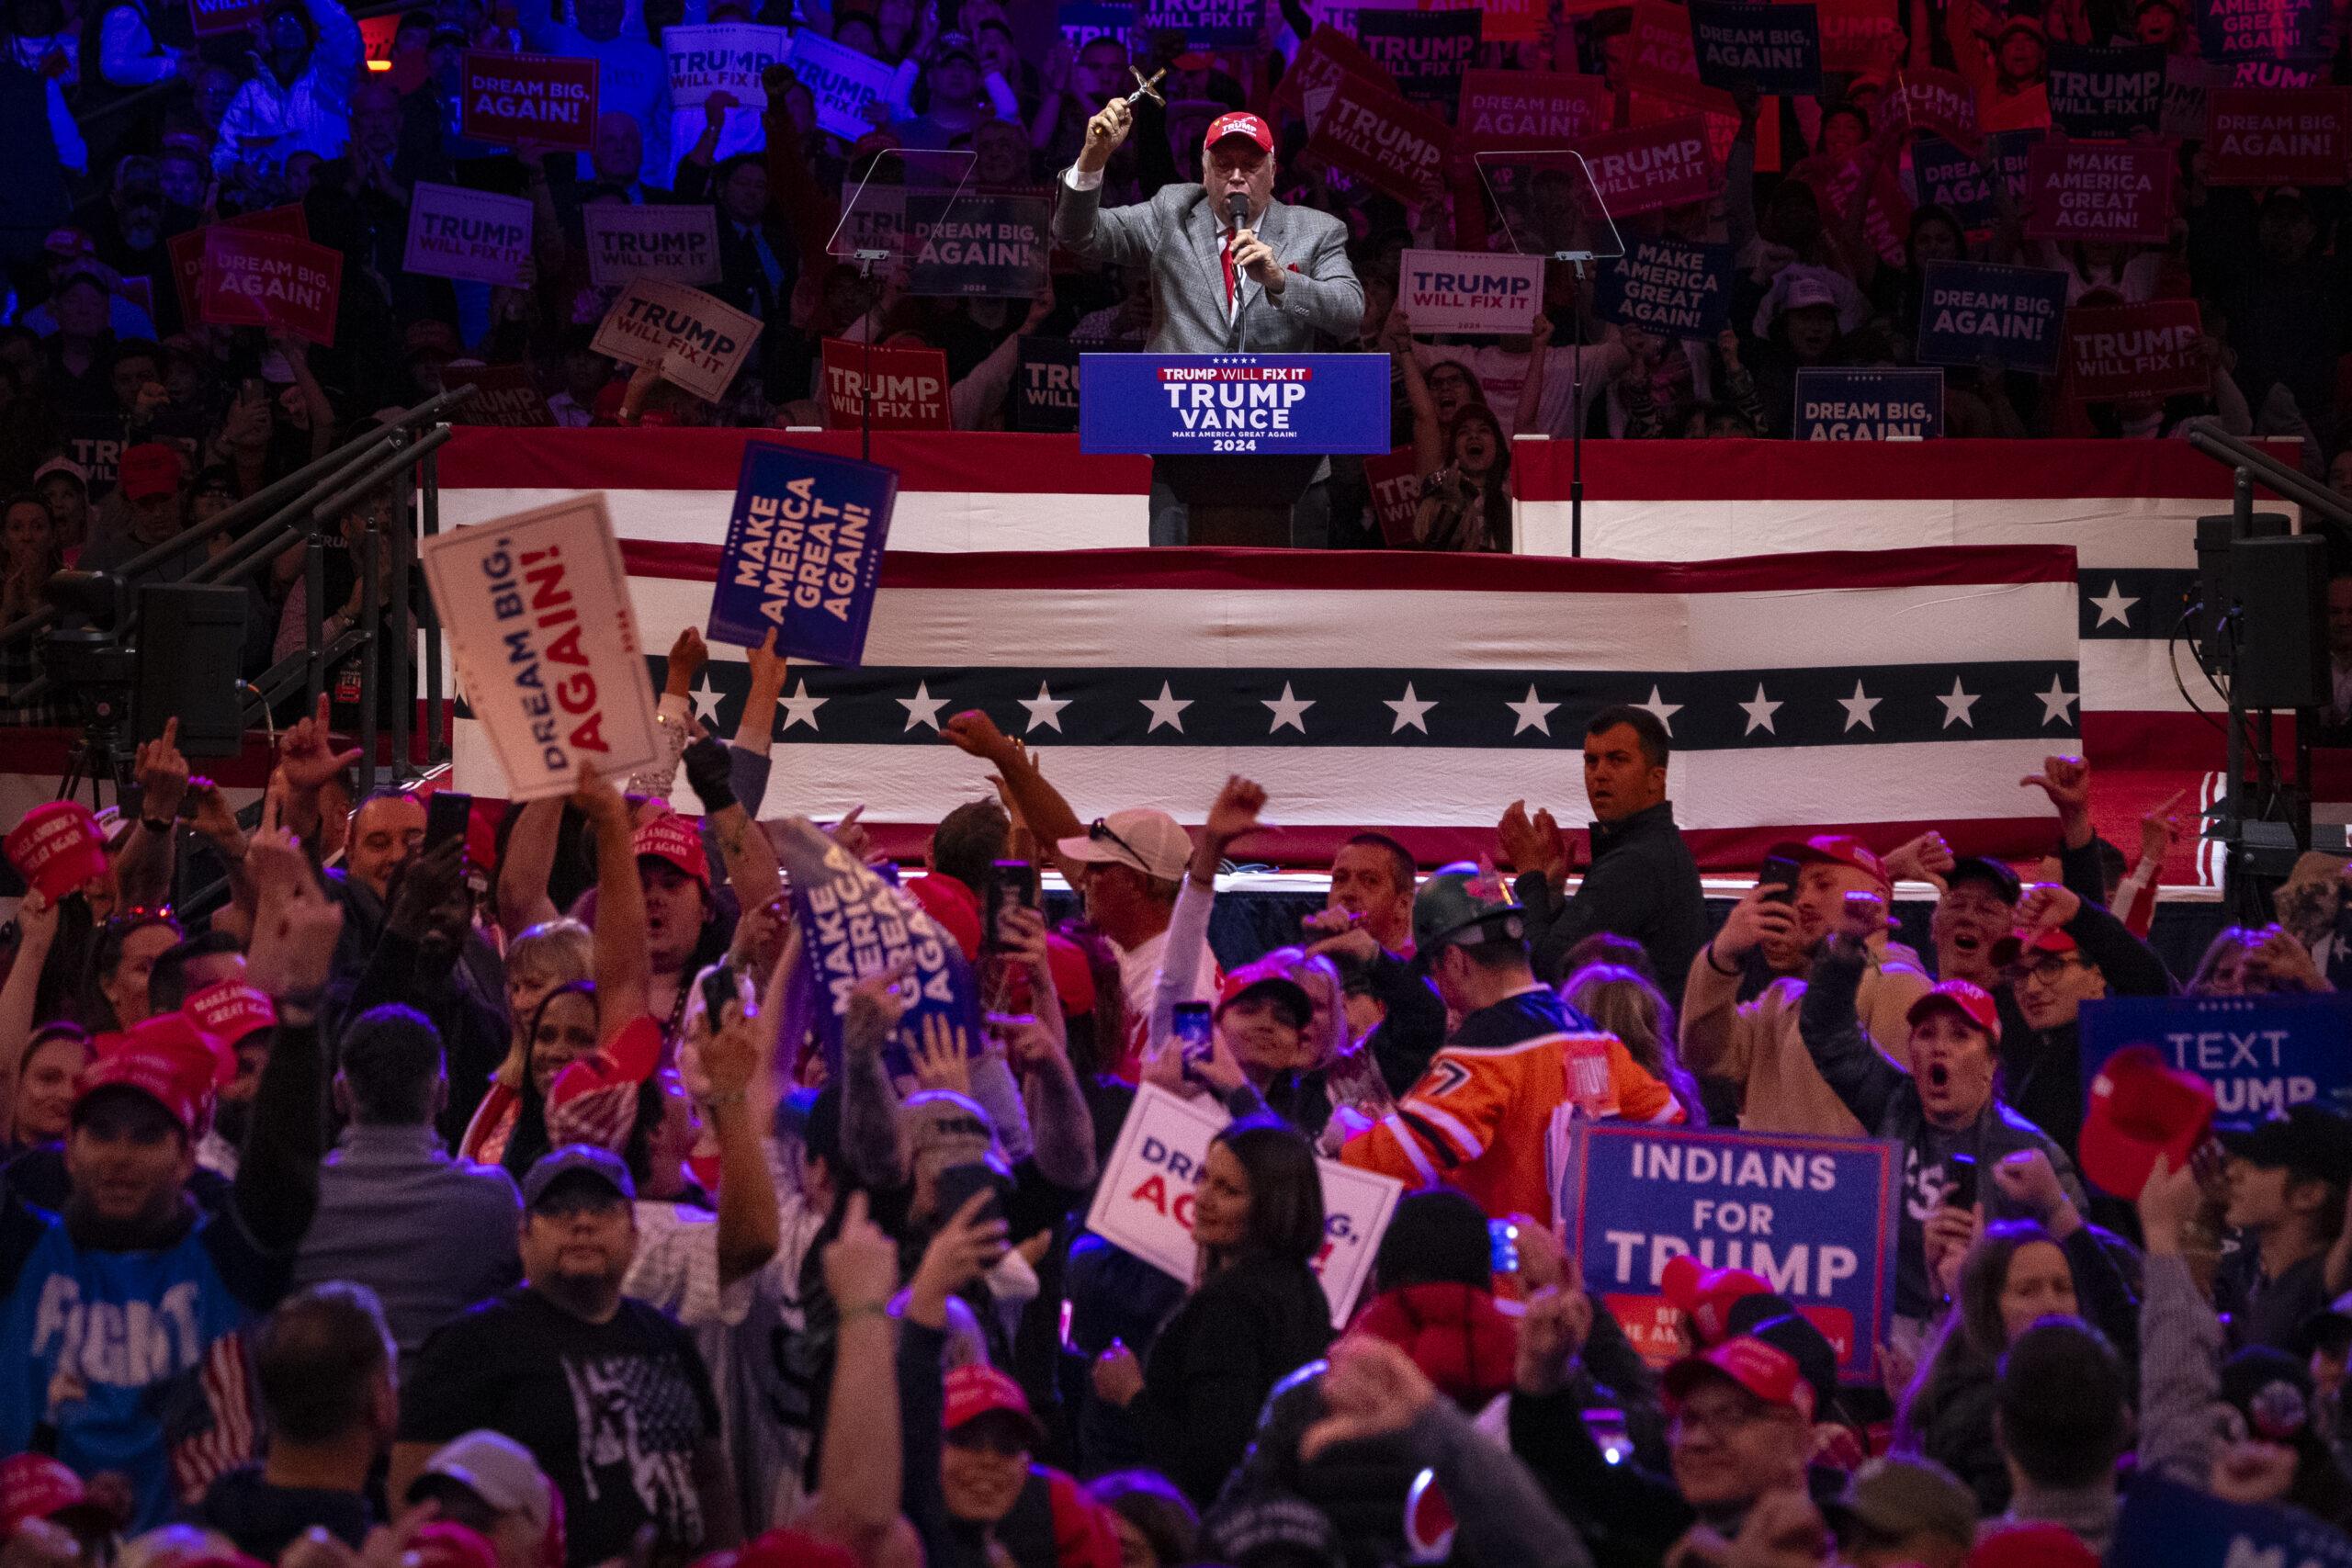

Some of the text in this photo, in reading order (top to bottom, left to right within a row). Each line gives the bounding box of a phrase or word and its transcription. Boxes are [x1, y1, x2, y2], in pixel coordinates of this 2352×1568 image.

[1145, 12, 1256, 28] WILL FIX IT
[1823, 17, 1896, 38] UMP
[1363, 35, 1474, 62] TRUMP
[1700, 23, 1811, 47] DREAM BIG,
[669, 50, 775, 73] TRUMP
[1379, 60, 1415, 76] ILL
[1420, 60, 1453, 76] FIX
[1638, 46, 1699, 78] AGA
[1706, 43, 1803, 69] AGAIN!
[471, 73, 590, 103] DREAM BIG,
[670, 73, 713, 89] WILL
[718, 72, 748, 86] FIX
[793, 56, 876, 104] TRUMP
[2050, 69, 2161, 98] TRUMP
[2235, 61, 2316, 88] RUM
[474, 93, 581, 124] AGAIN!
[1472, 95, 1589, 117] DREAM BIG,
[2050, 96, 2098, 115] WILL
[2103, 97, 2138, 115] FIX
[2143, 95, 2159, 113] IT
[1338, 96, 1442, 167] TRUMP
[1473, 111, 1581, 138] AGAIN!
[2217, 114, 2341, 133] DREAM BIG,
[1329, 119, 1371, 157] WILL
[1376, 147, 1410, 177] FIX
[2219, 133, 2332, 157] AGAIN!
[1582, 139, 1702, 182] TRUMP
[1645, 167, 1679, 187] FIX
[1684, 160, 1704, 178] IT
[2066, 153, 2134, 172] MAKE
[1933, 174, 2027, 206] AGAN
[2044, 172, 2153, 191] AMERICA
[2058, 191, 2139, 209] GREAT
[422, 212, 524, 247] TRUMP
[915, 221, 1040, 244] DREAM BIG,
[2055, 209, 2139, 229] AGAIN!
[419, 235, 522, 263] WILL FIX IT
[597, 231, 707, 253] TRUMP
[918, 242, 1031, 266] AGAIN!
[601, 252, 707, 266] WILL FIX IT
[1637, 243, 1705, 272] MAKE
[216, 253, 293, 278] DREAM
[297, 265, 332, 294] BIG,
[1413, 271, 1532, 296] TRUMP
[1612, 257, 1719, 293] AMERICA
[218, 271, 322, 312] AGAIN!
[1413, 292, 1530, 310] WILL FIX IT
[1623, 276, 1705, 310] GREAT
[1932, 288, 2056, 320] DREAM BIG,
[626, 296, 736, 356] TRUMP
[1617, 299, 1703, 330] AGAIN!
[1932, 309, 2046, 342] AGAIN!
[615, 315, 662, 345] WILL
[666, 335, 701, 365] FIX
[701, 354, 725, 375] IT
[2072, 323, 2197, 360] TRUMP
[1163, 368, 1306, 380] TRUMP WILL FIX IT
[2075, 357, 2132, 378] WILL
[2134, 353, 2173, 375] FIX
[828, 366, 941, 402] TRUMP
[1163, 383, 1306, 408] TRUMP
[877, 401, 914, 419] FIX
[920, 402, 941, 419] IT
[1180, 409, 1290, 430] VANCE
[1804, 401, 1933, 423] DREAM BIG,
[1213, 439, 1257, 452] 2024
[1809, 422, 1922, 441] AGAIN!
[733, 495, 780, 589] MAKE
[759, 476, 817, 626] AMERICA
[794, 497, 841, 609] GREAT
[822, 502, 872, 622] AGAIN!
[481, 536, 570, 772] DREAM BIG,
[520, 544, 609, 754] AGAIN!
[823, 844, 885, 978] ERICA
[807, 883, 857, 1016] MAKE
[2165, 1029, 2290, 1070] TEXT
[2212, 1075, 2318, 1114] UMP
[1631, 1142, 1838, 1192] INDIANS
[1324, 1213, 1359, 1245] G,
[1692, 1199, 1775, 1235] FOR
